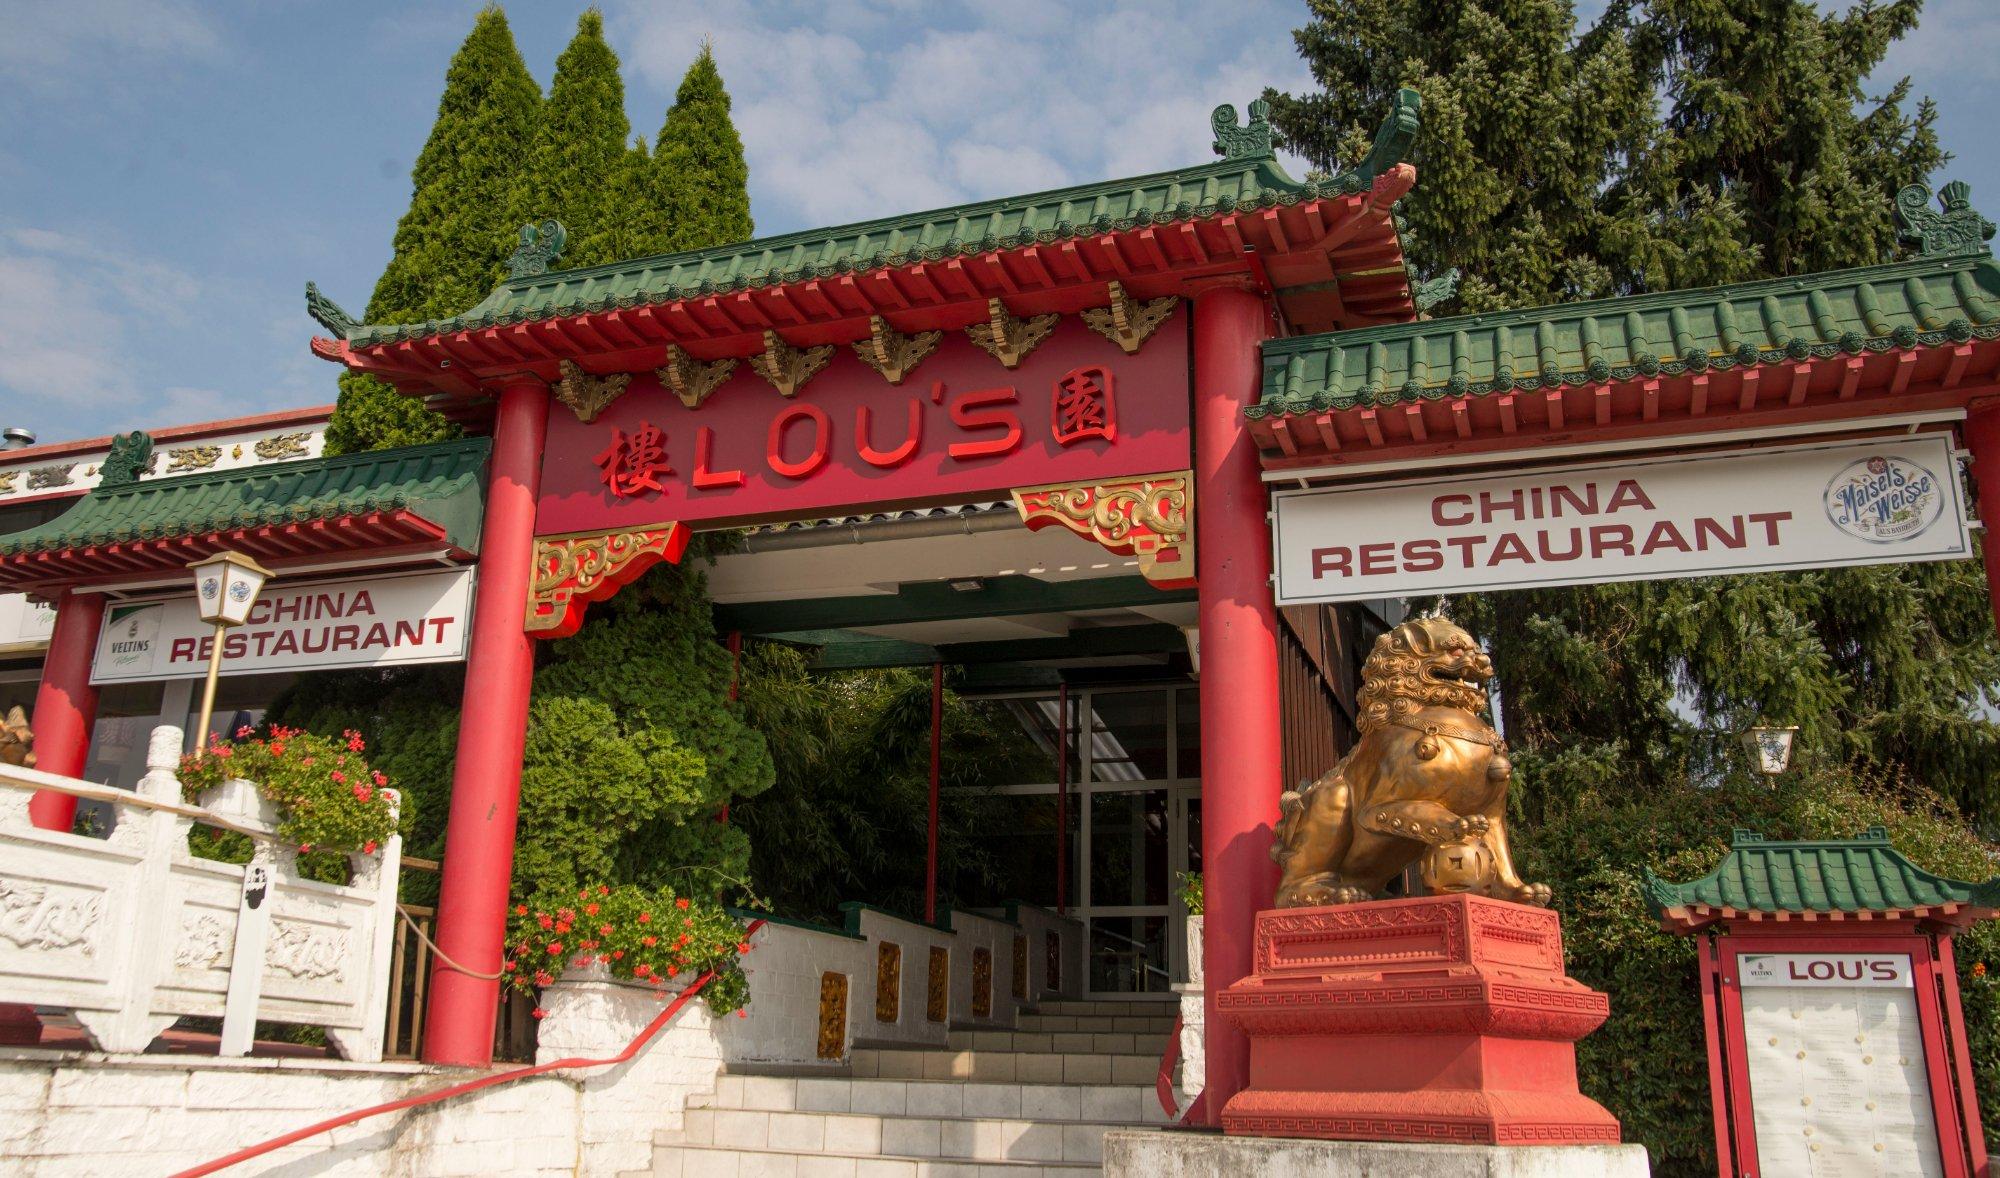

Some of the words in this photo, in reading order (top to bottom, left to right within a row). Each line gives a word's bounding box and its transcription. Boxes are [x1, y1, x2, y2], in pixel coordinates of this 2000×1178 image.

[592, 418, 672, 498] 樓
[693, 380, 1024, 489] LOU'S
[1051, 364, 1117, 444] 園
[1432, 479, 1656, 527] CHINA
[1836, 463, 1906, 524] Maisel's
[1869, 476, 1931, 523] Weisse
[1312, 511, 1792, 580] RESTAURANT
[246, 590, 376, 625] CHINA
[111, 640, 150, 654] VELTINS
[169, 617, 455, 663] RESTAURANT
[1788, 959, 1898, 981] LOU'S
